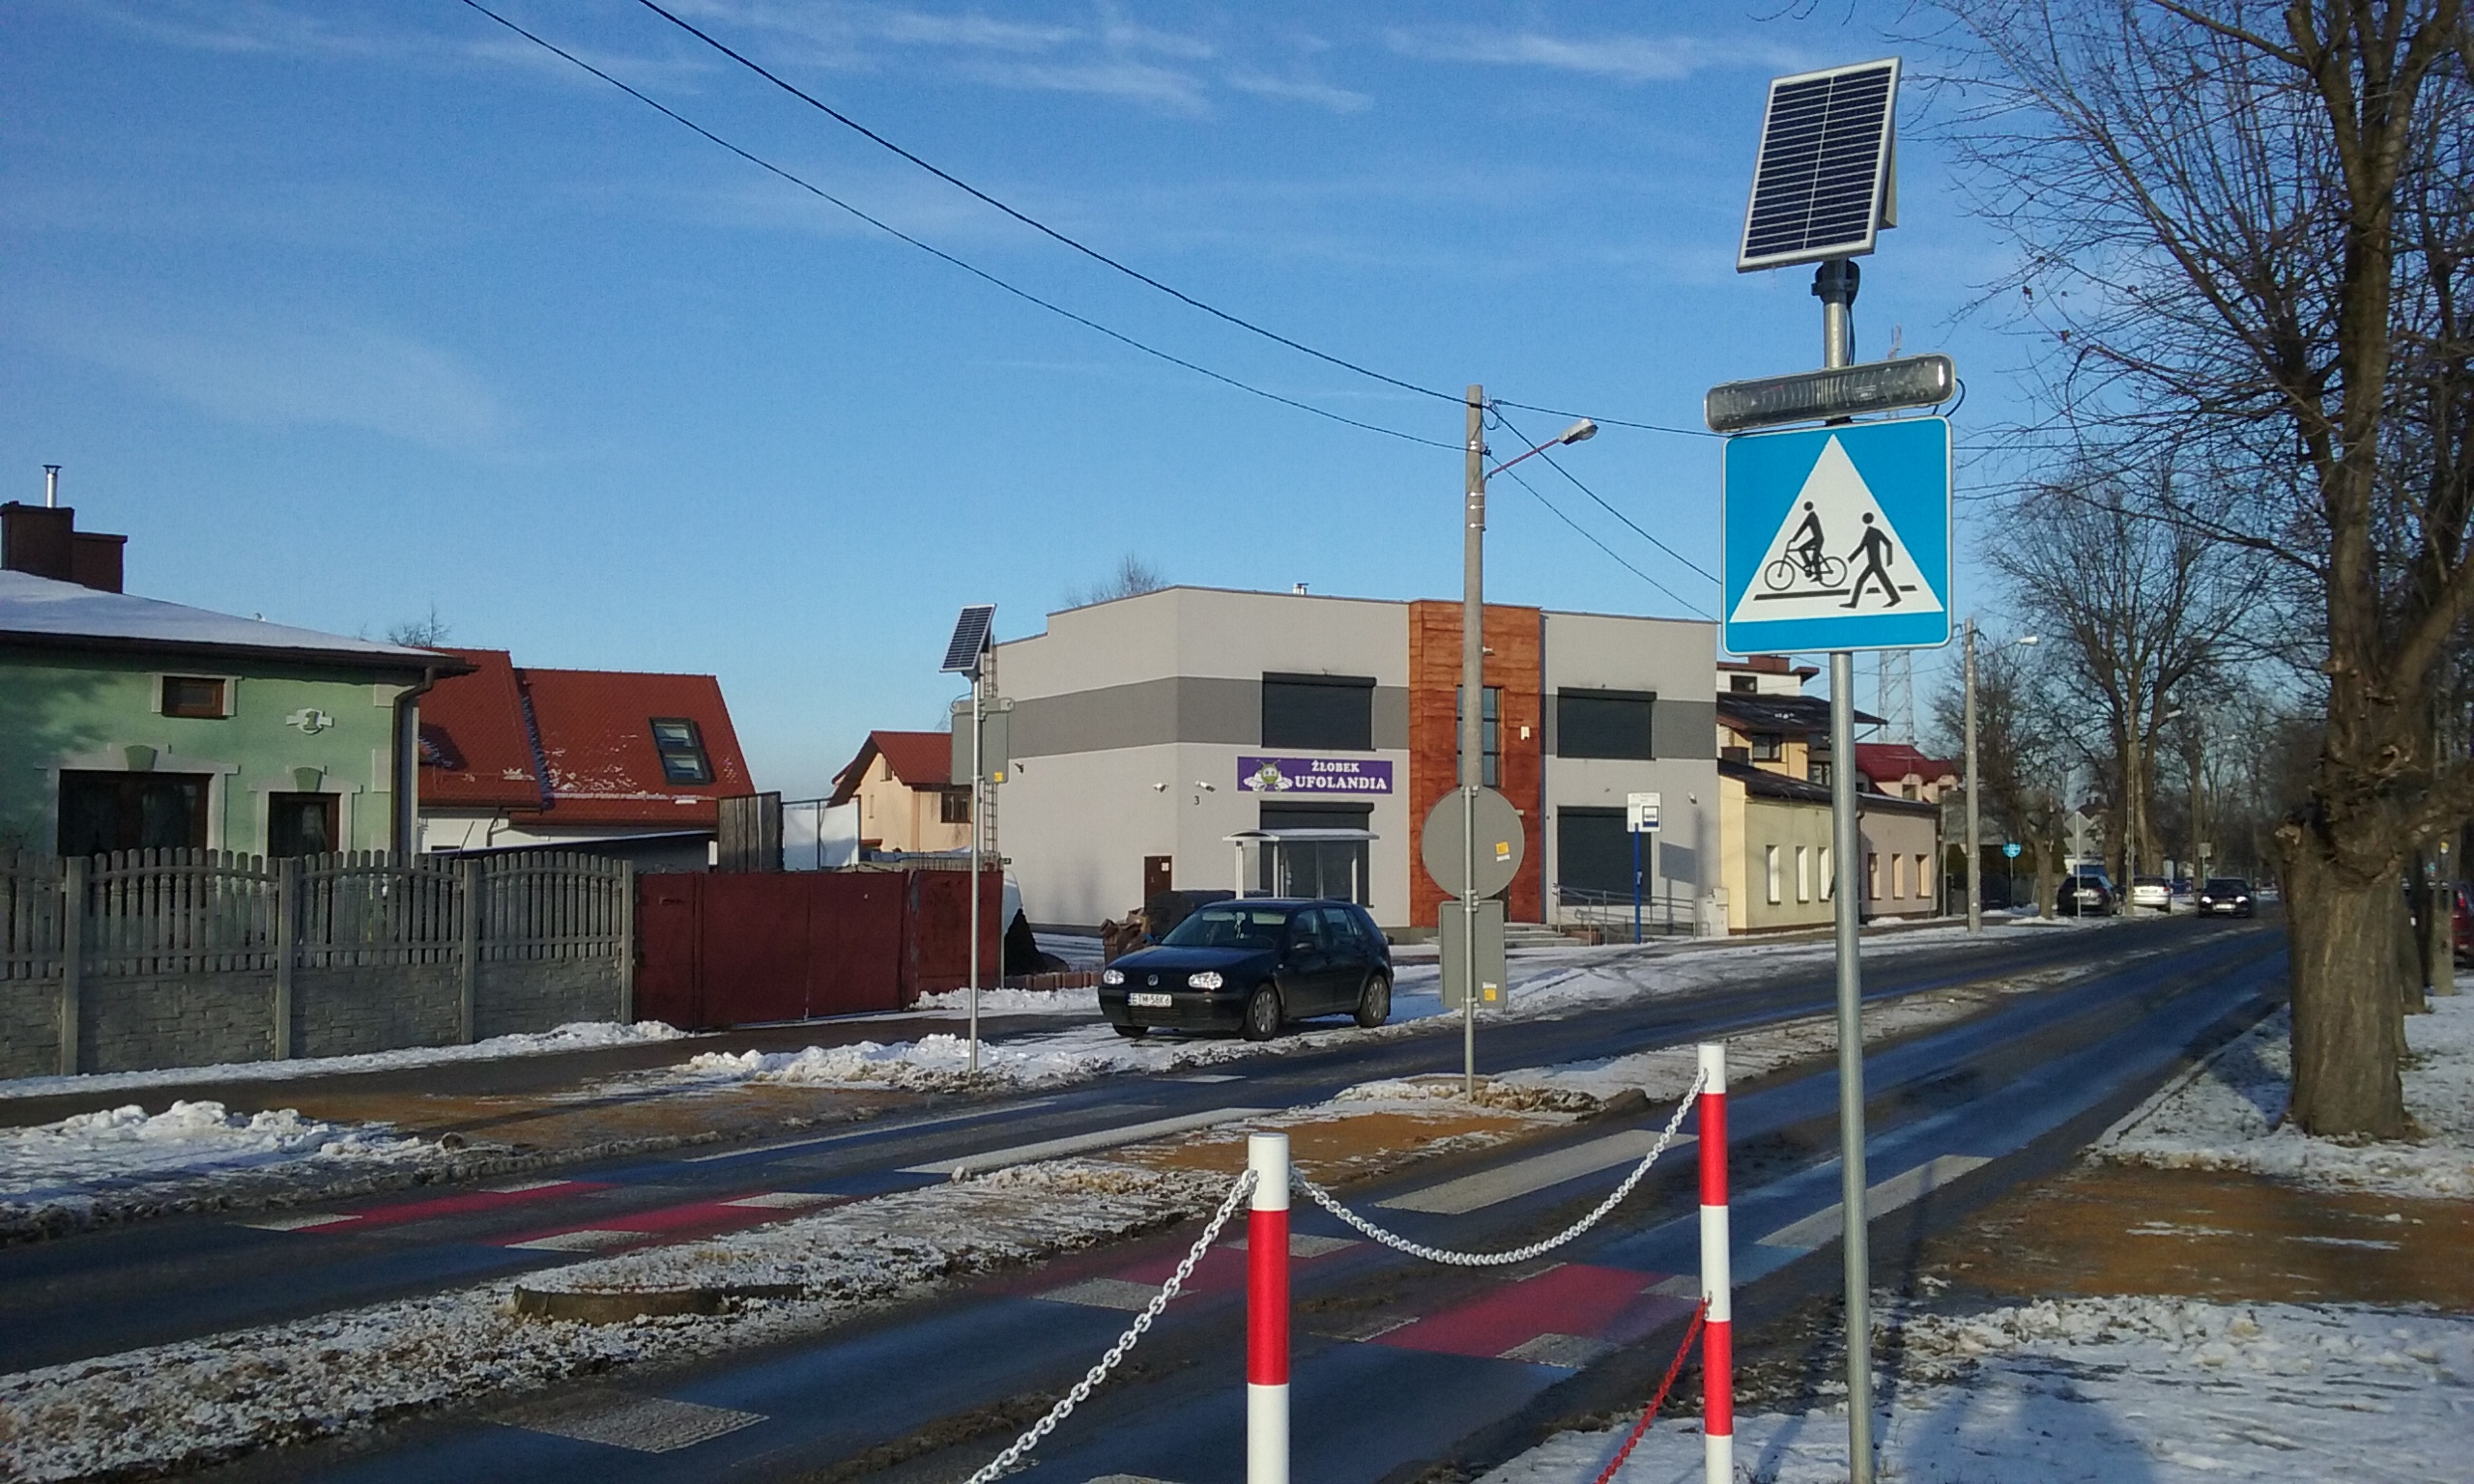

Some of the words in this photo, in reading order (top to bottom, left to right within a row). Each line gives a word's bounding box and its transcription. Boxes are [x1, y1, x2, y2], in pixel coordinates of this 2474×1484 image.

[1311, 760, 1360, 773] ŻŁOBEK
[1295, 775, 1387, 789] UFOLANDIA
[1194, 795, 1200, 806] 3
